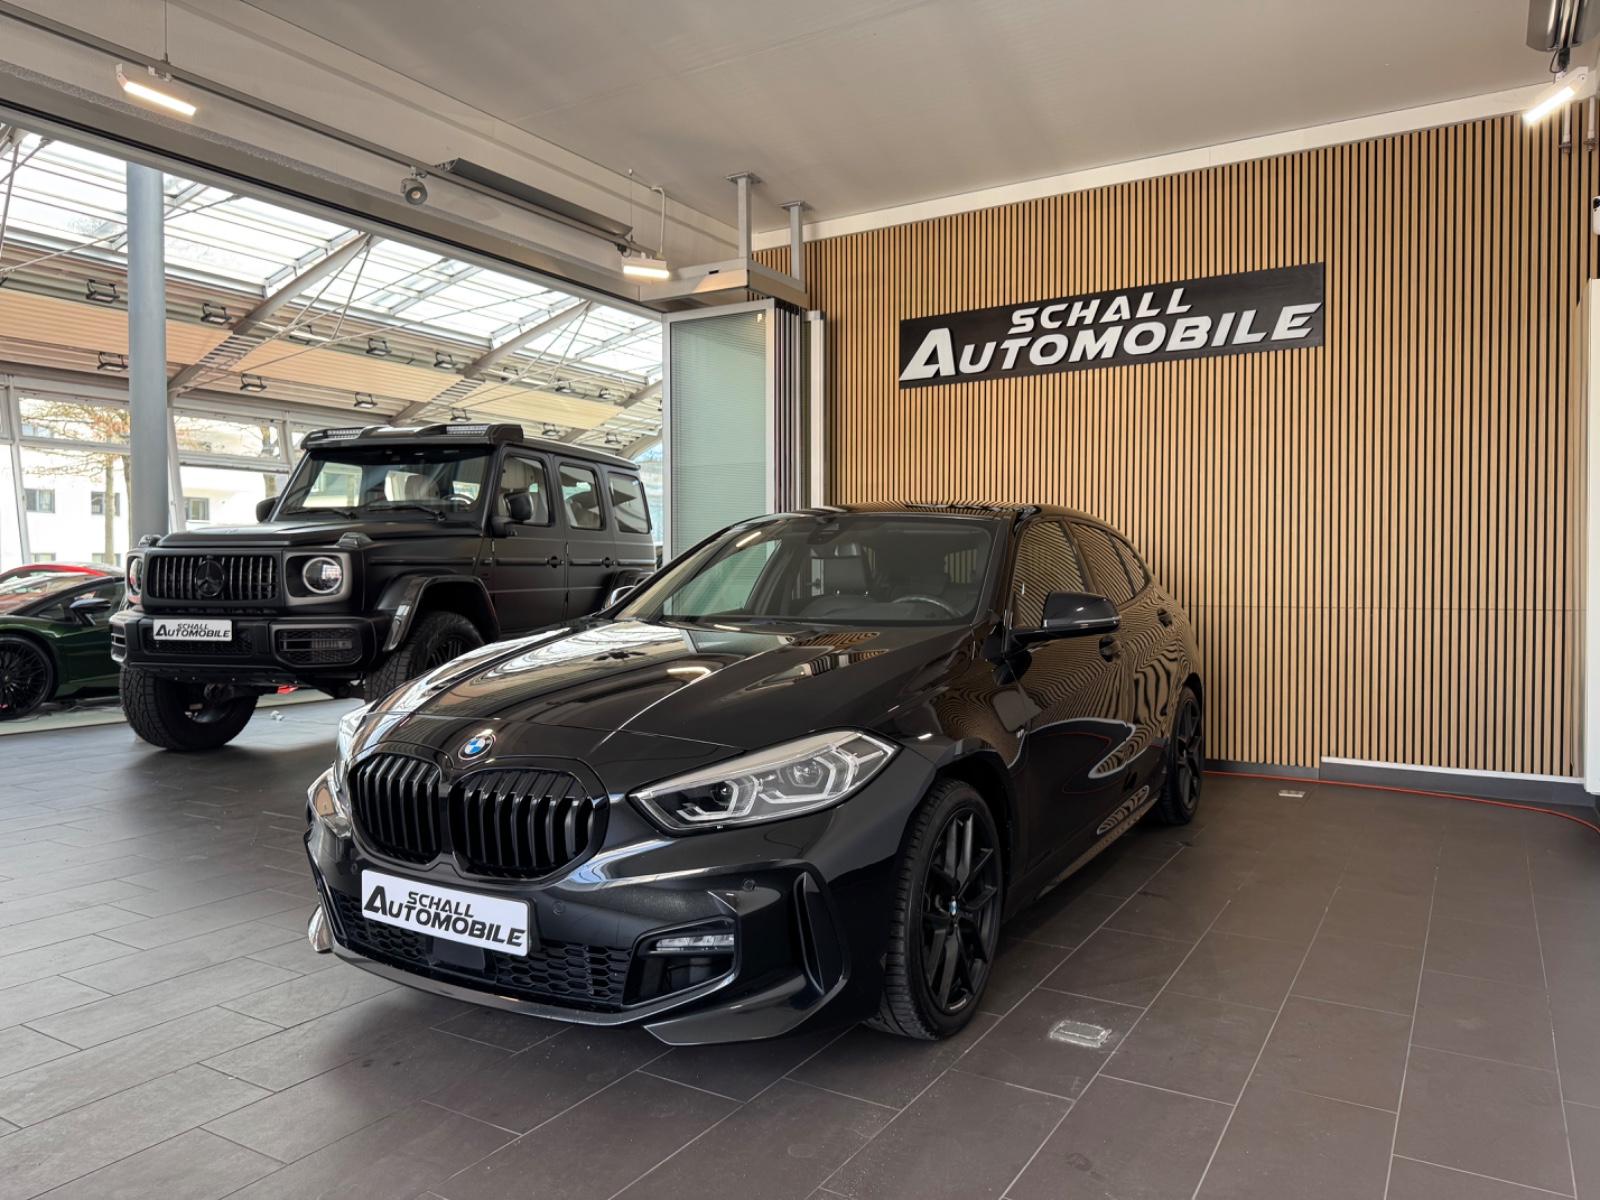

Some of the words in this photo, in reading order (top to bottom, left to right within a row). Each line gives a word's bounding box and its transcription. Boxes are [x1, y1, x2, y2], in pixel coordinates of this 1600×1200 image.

[1008, 288, 1192, 334] SCHALL
[899, 302, 1322, 381] AUTOMOBILE
[155, 624, 230, 637] AUTOMOBILE
[364, 885, 527, 947] AUTOMOBILE
[406, 891, 474, 918] SCHALL
